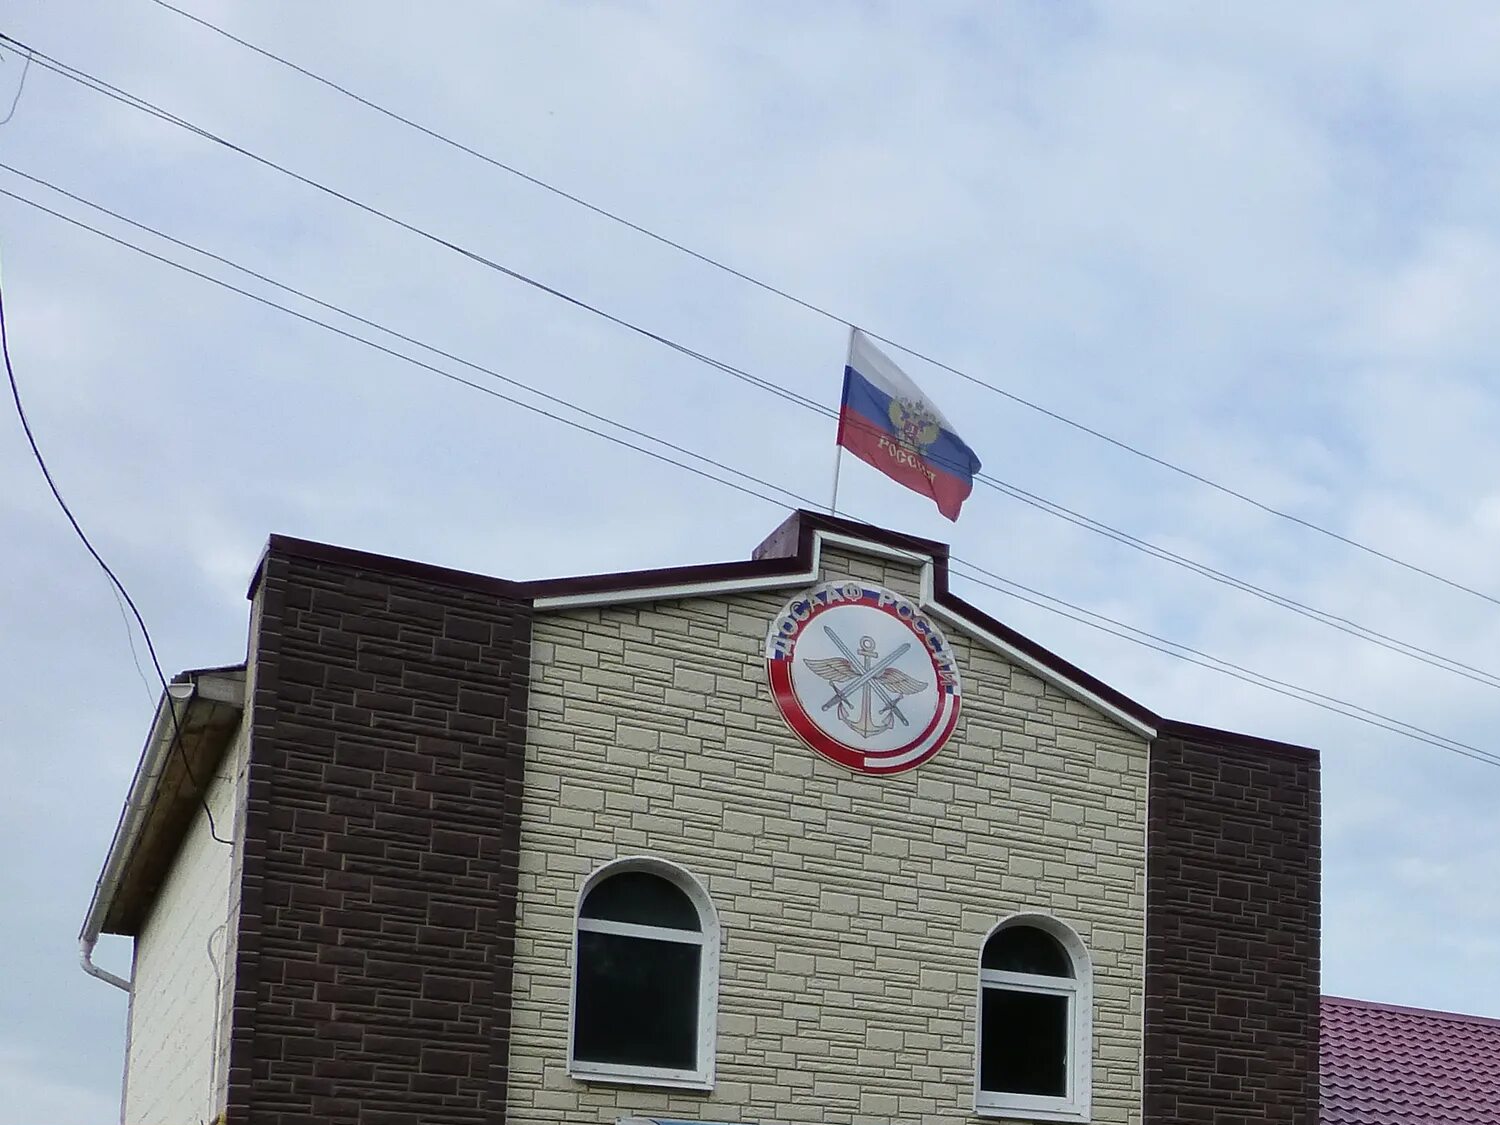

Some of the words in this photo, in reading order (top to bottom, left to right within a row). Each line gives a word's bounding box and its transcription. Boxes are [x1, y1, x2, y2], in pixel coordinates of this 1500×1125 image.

[877, 436, 936, 482] РОССИЯ
[771, 583, 863, 657] ДОСААФ
[877, 589, 959, 687] РОССИИ
